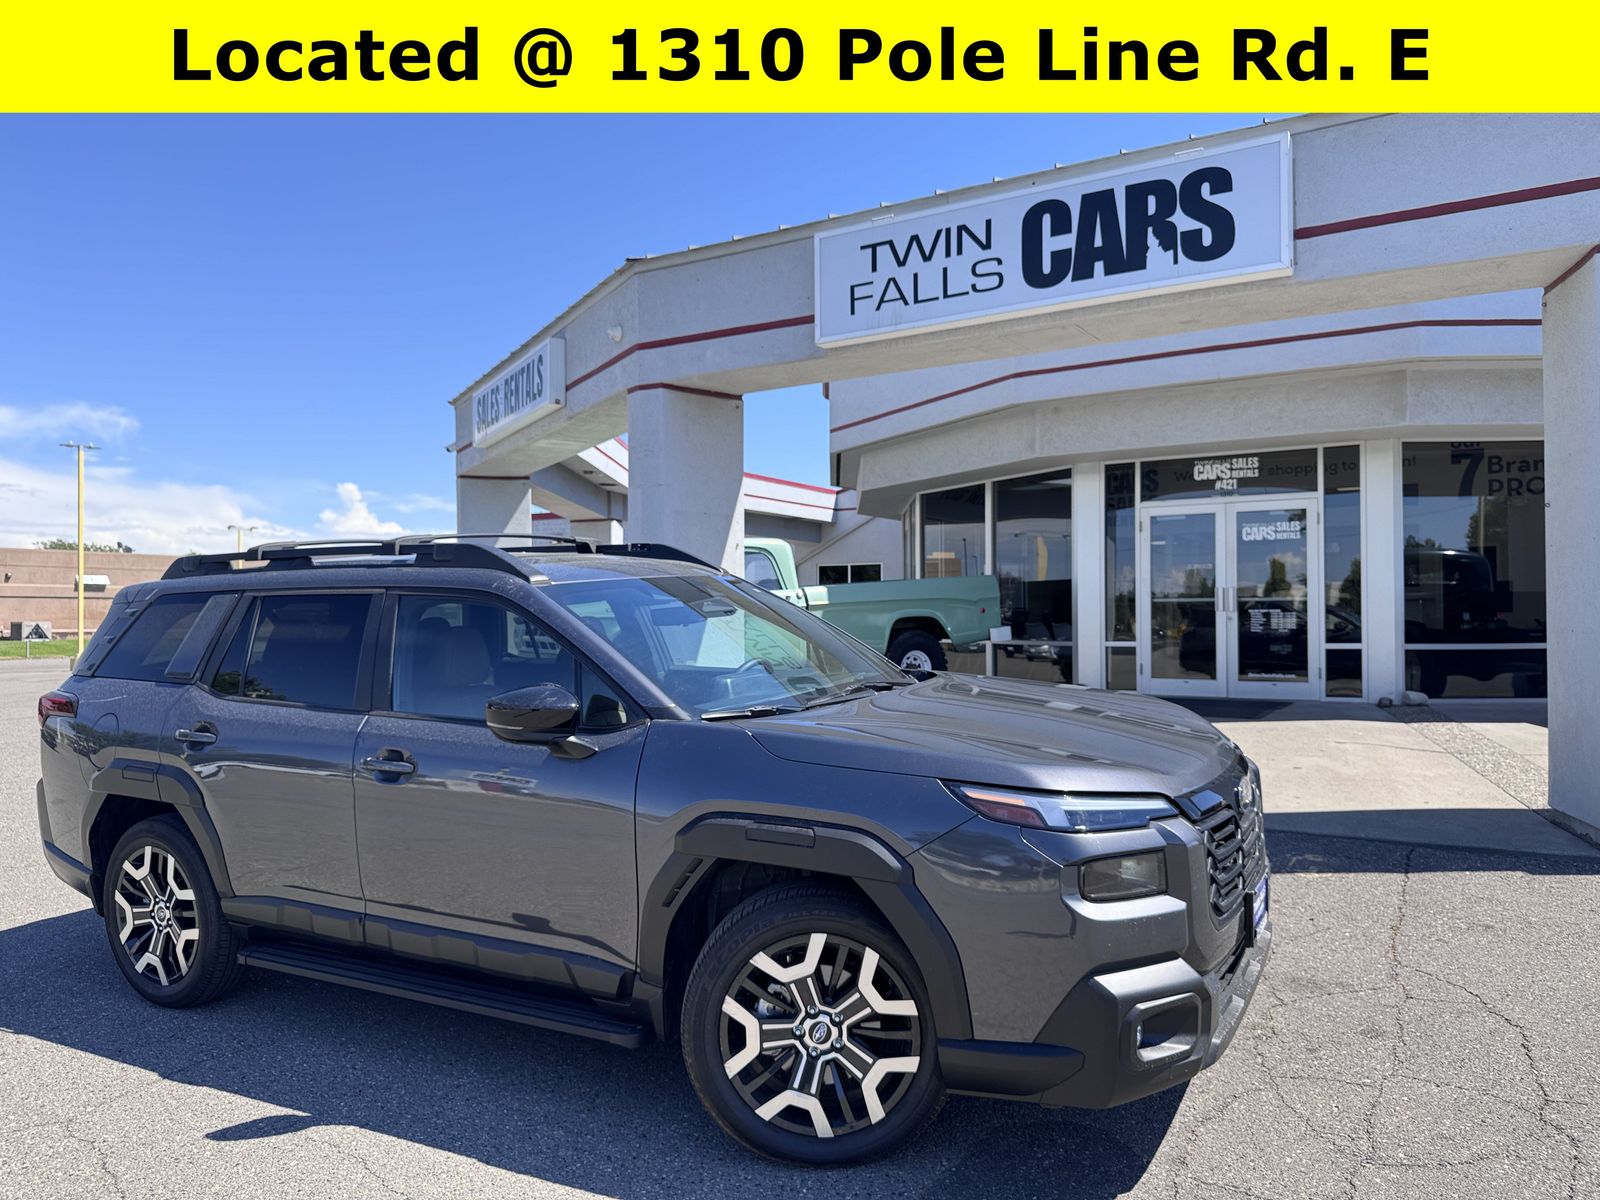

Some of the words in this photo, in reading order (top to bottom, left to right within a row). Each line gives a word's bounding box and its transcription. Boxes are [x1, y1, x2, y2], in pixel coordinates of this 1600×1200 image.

[1021, 166, 1236, 289] CARS
[860, 218, 992, 273] TWIN
[850, 257, 1004, 316] FALLS
[476, 384, 500, 434] SALES
[503, 353, 543, 419] RENTALS
[1231, 456, 1259, 469] SALES
[1193, 463, 1231, 481] CARS
[1231, 469, 1259, 478] RENTALS
[1215, 479, 1237, 490] #421
[1242, 526, 1276, 541] CARS
[1276, 521, 1301, 532] SALES
